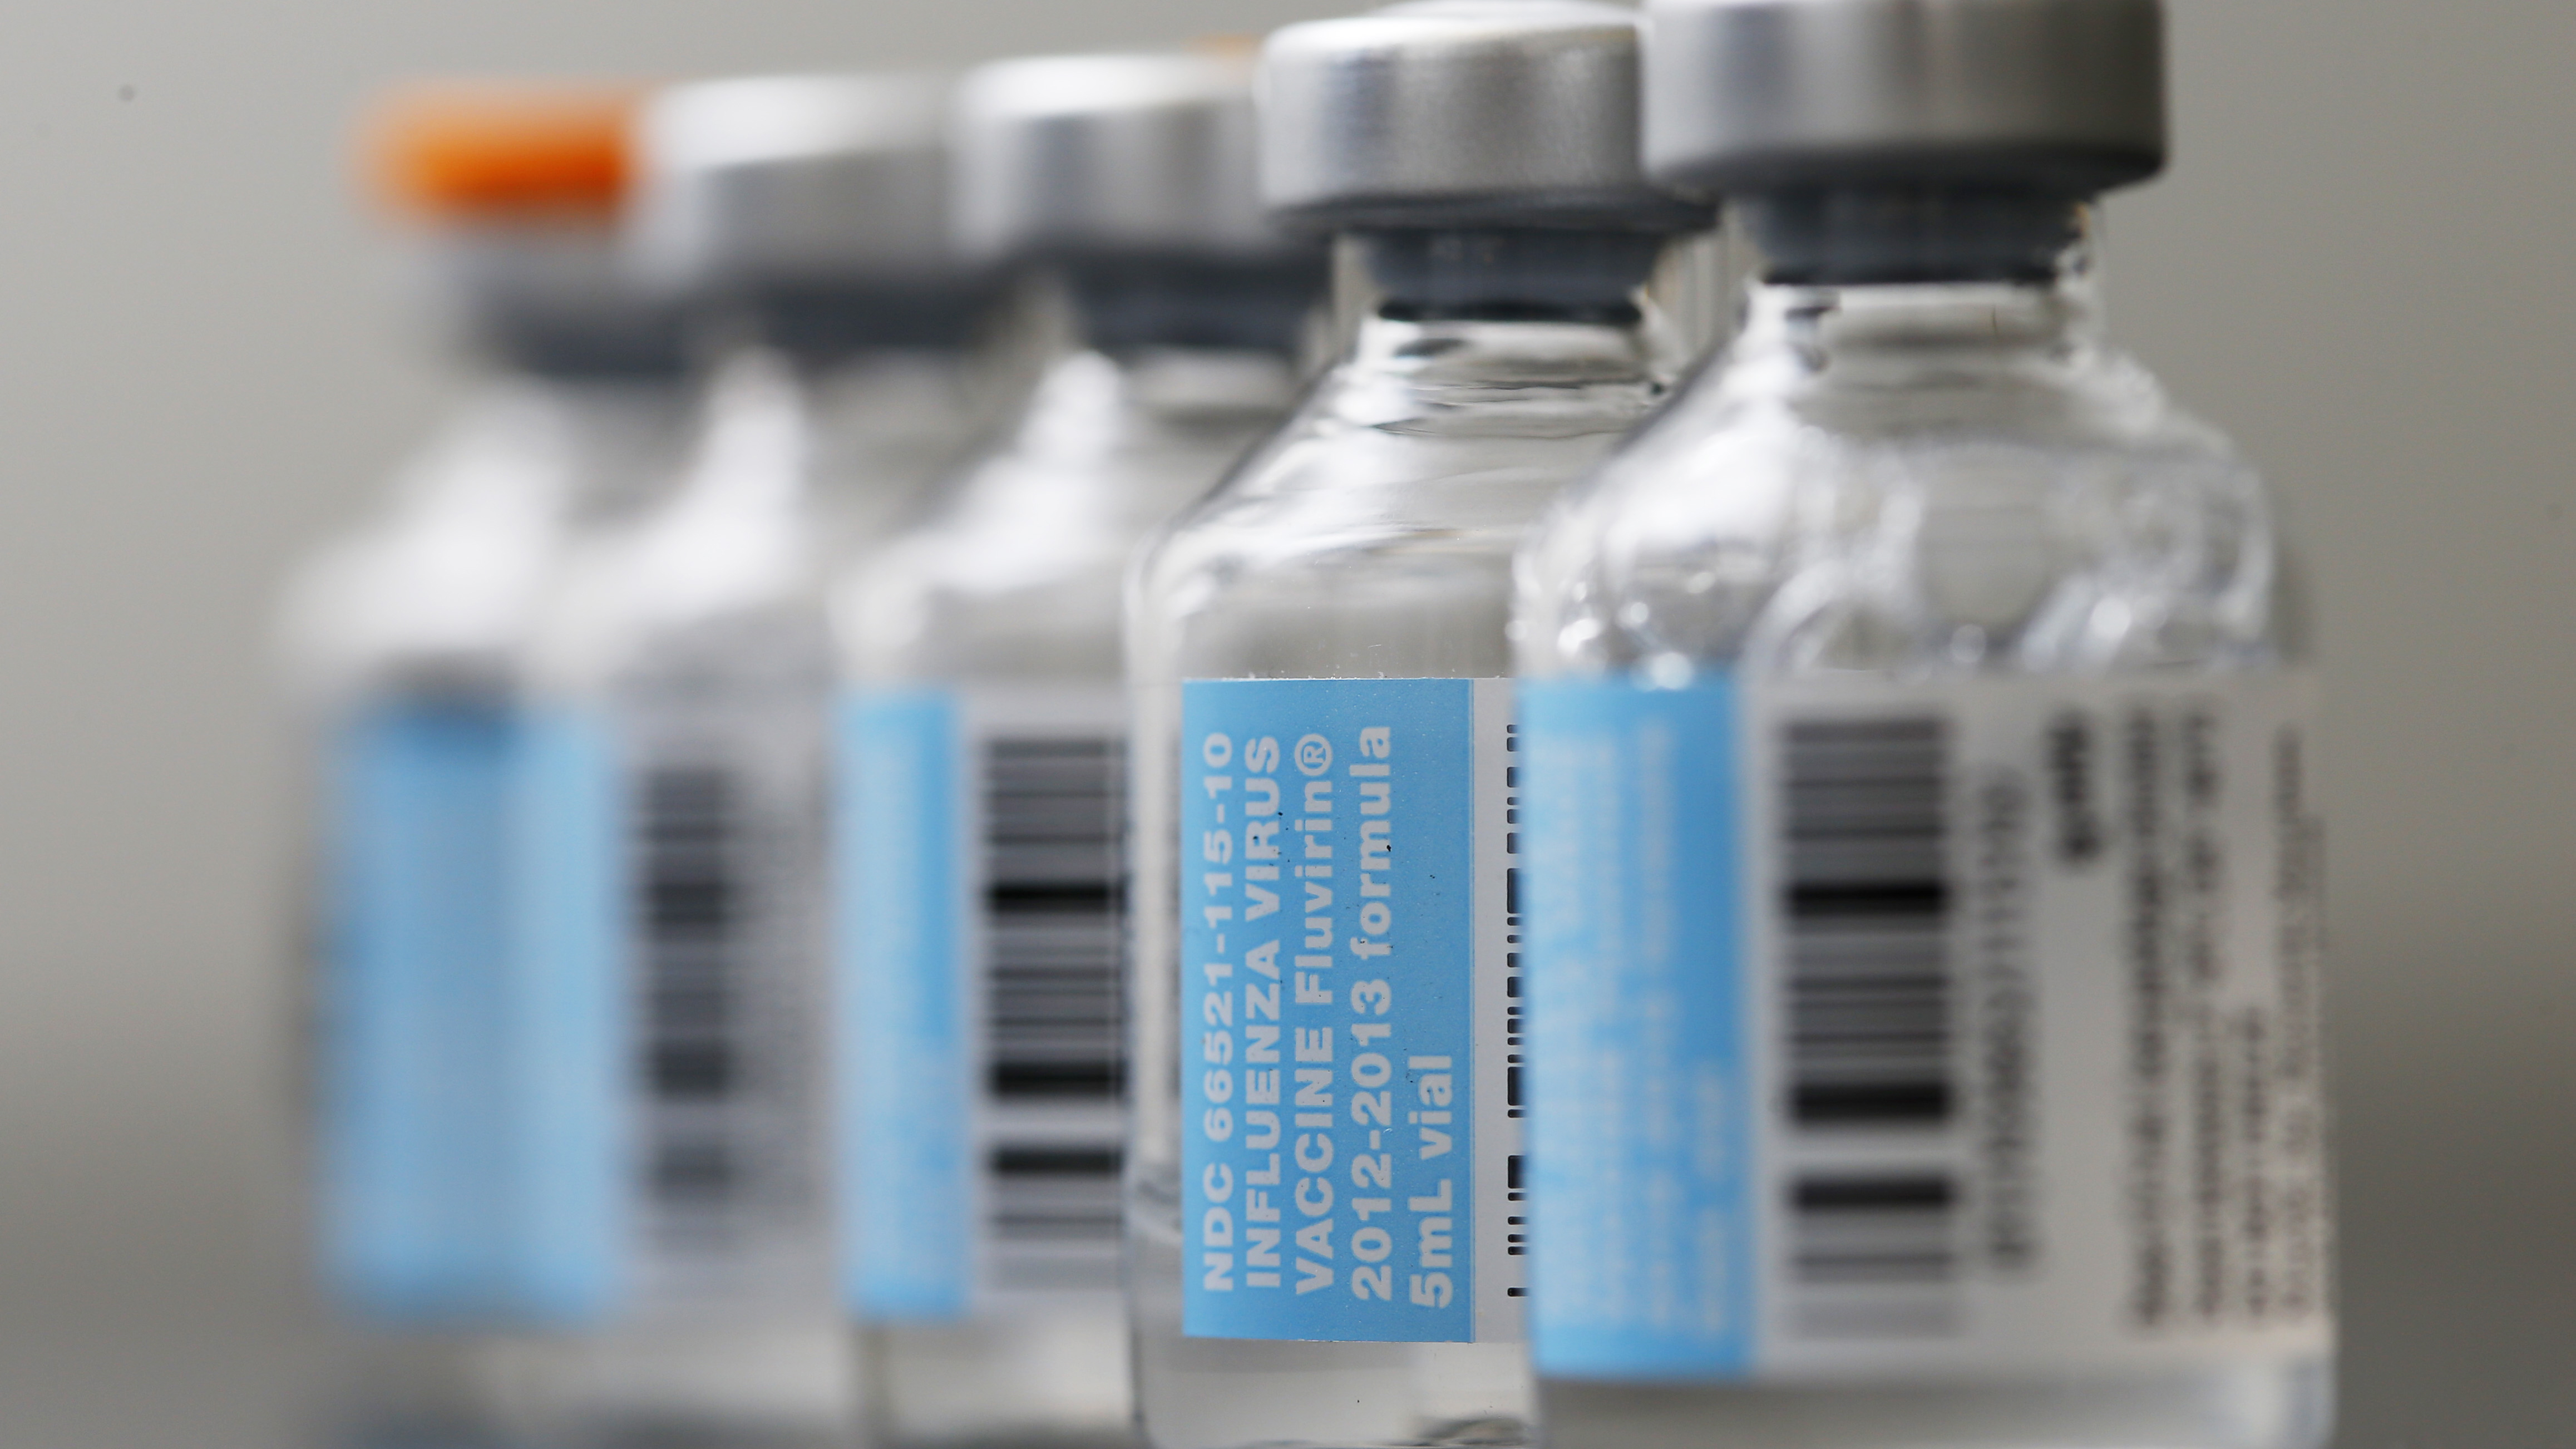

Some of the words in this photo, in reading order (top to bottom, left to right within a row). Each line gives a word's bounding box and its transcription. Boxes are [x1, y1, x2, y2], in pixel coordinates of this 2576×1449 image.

[1201, 733, 1233, 1141] 66521-115-10
[1245, 737, 1280, 920] VIRUS
[1294, 733, 1333, 1003] Fluvirin®
[1350, 727, 1391, 959] formula
[1203, 1164, 1233, 1290] NDC
[1246, 940, 1280, 1287] INFLUENZA
[1295, 1027, 1334, 1294] VACCINE
[1351, 979, 1391, 1300] 2012-2013
[1409, 1056, 1452, 1159] vial
[1409, 1179, 1453, 1308] 5mL
